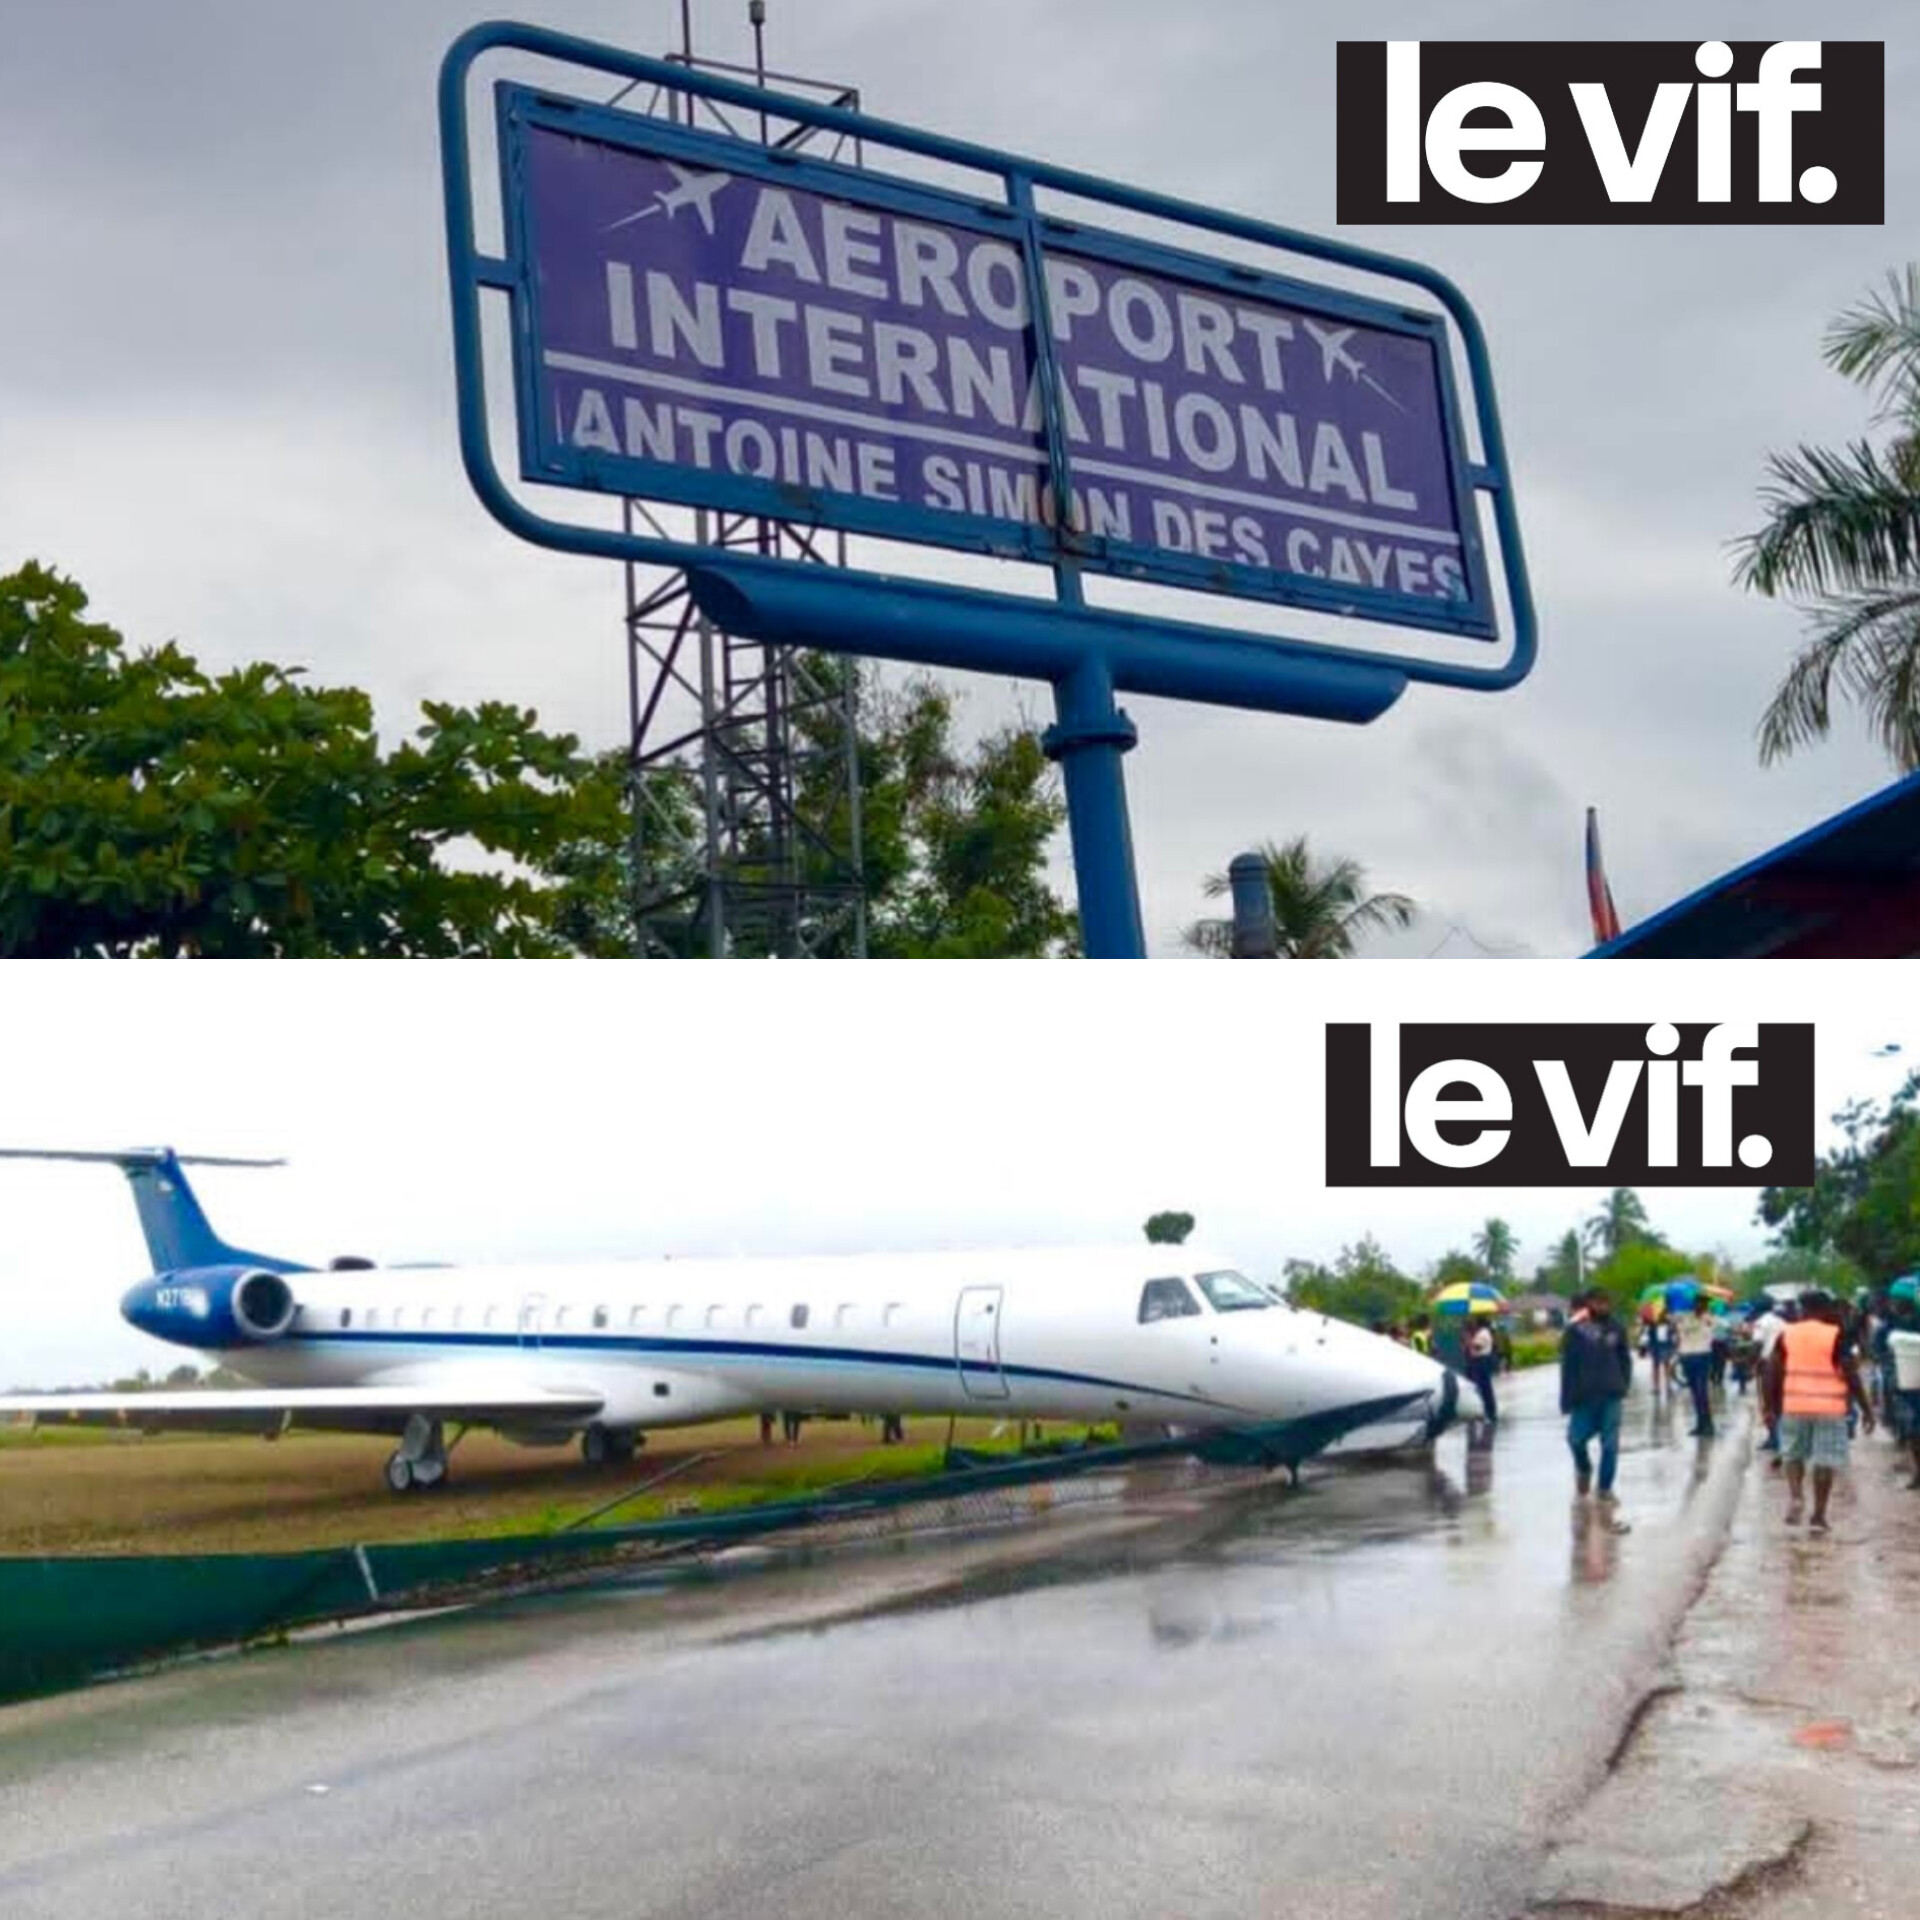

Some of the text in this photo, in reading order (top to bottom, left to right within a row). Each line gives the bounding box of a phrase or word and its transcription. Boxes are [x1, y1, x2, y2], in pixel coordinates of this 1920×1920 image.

[606, 262, 1417, 510] INTERNATIONAL
[741, 188, 1294, 392] AEROPORT
[573, 389, 1468, 600] ANTOINE SIMON DES CAYES
